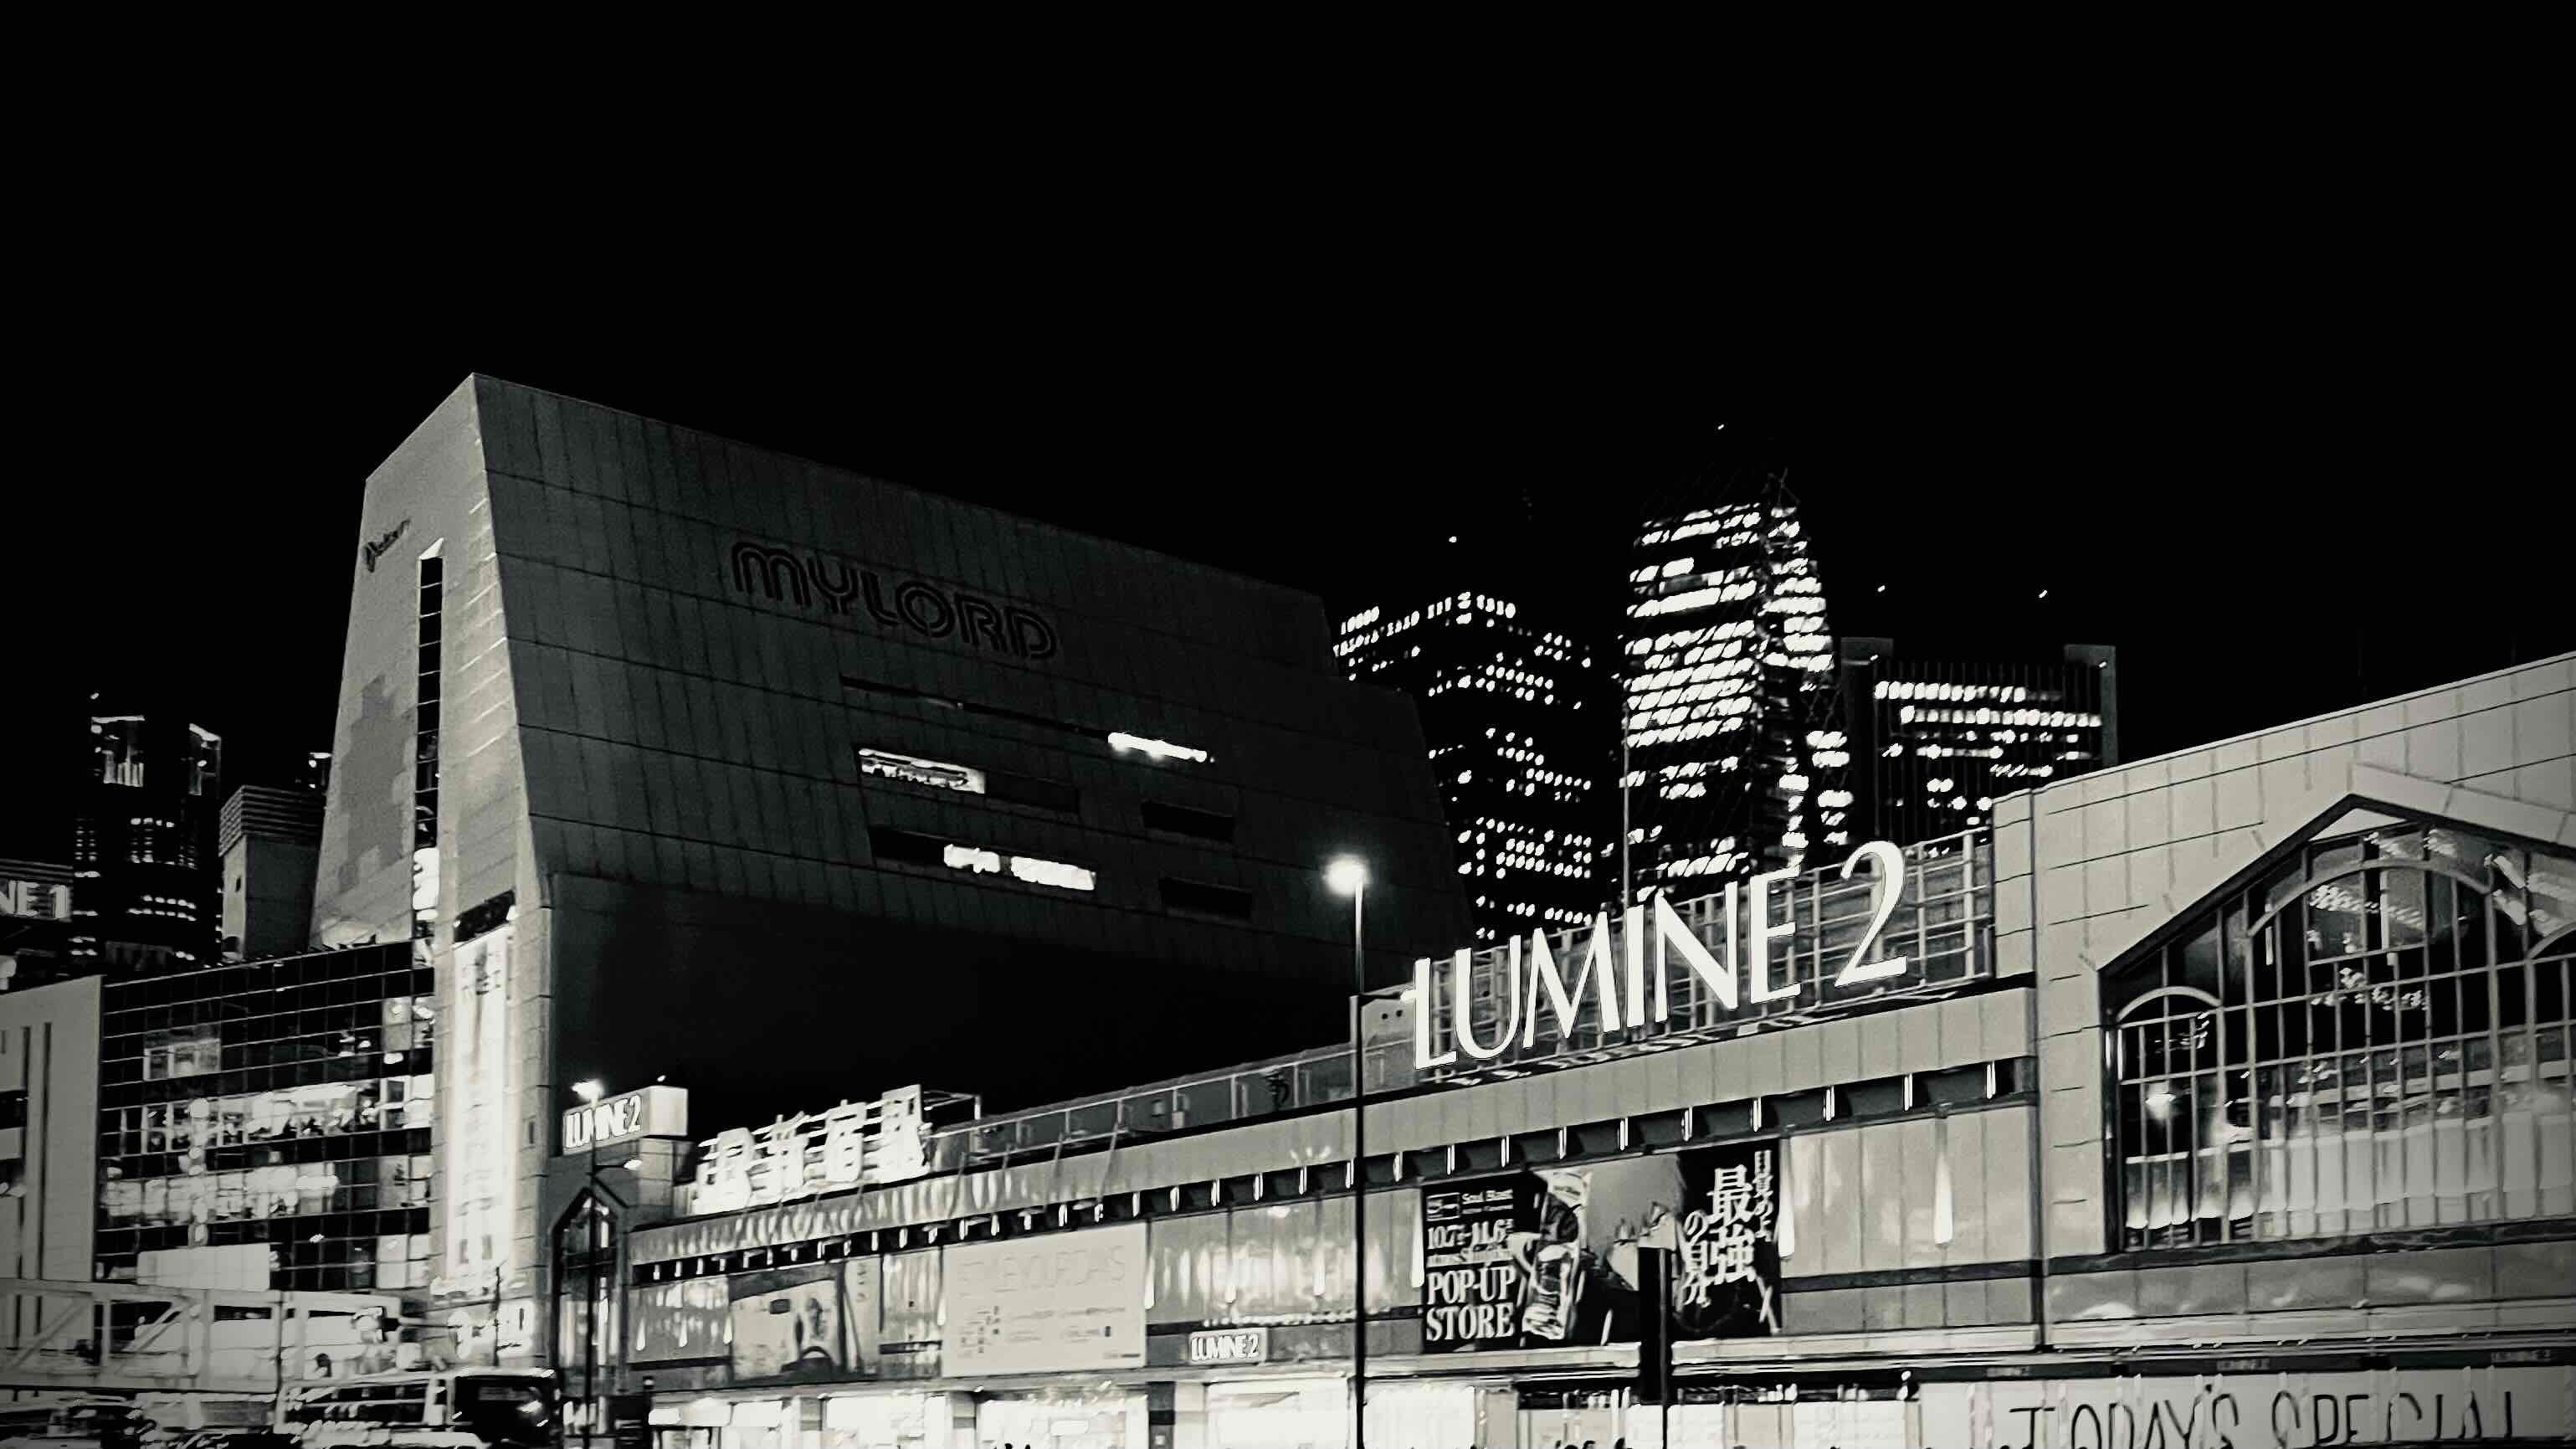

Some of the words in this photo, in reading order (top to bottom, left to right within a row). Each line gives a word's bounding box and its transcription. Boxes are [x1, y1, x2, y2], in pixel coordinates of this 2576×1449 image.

[731, 542, 1057, 660] MYLORD
[1414, 866, 1801, 1070] LUMINE
[1835, 840, 1908, 988] 2
[1425, 1303, 1515, 1342] STORE
[1426, 1265, 1516, 1305] POP-UP
